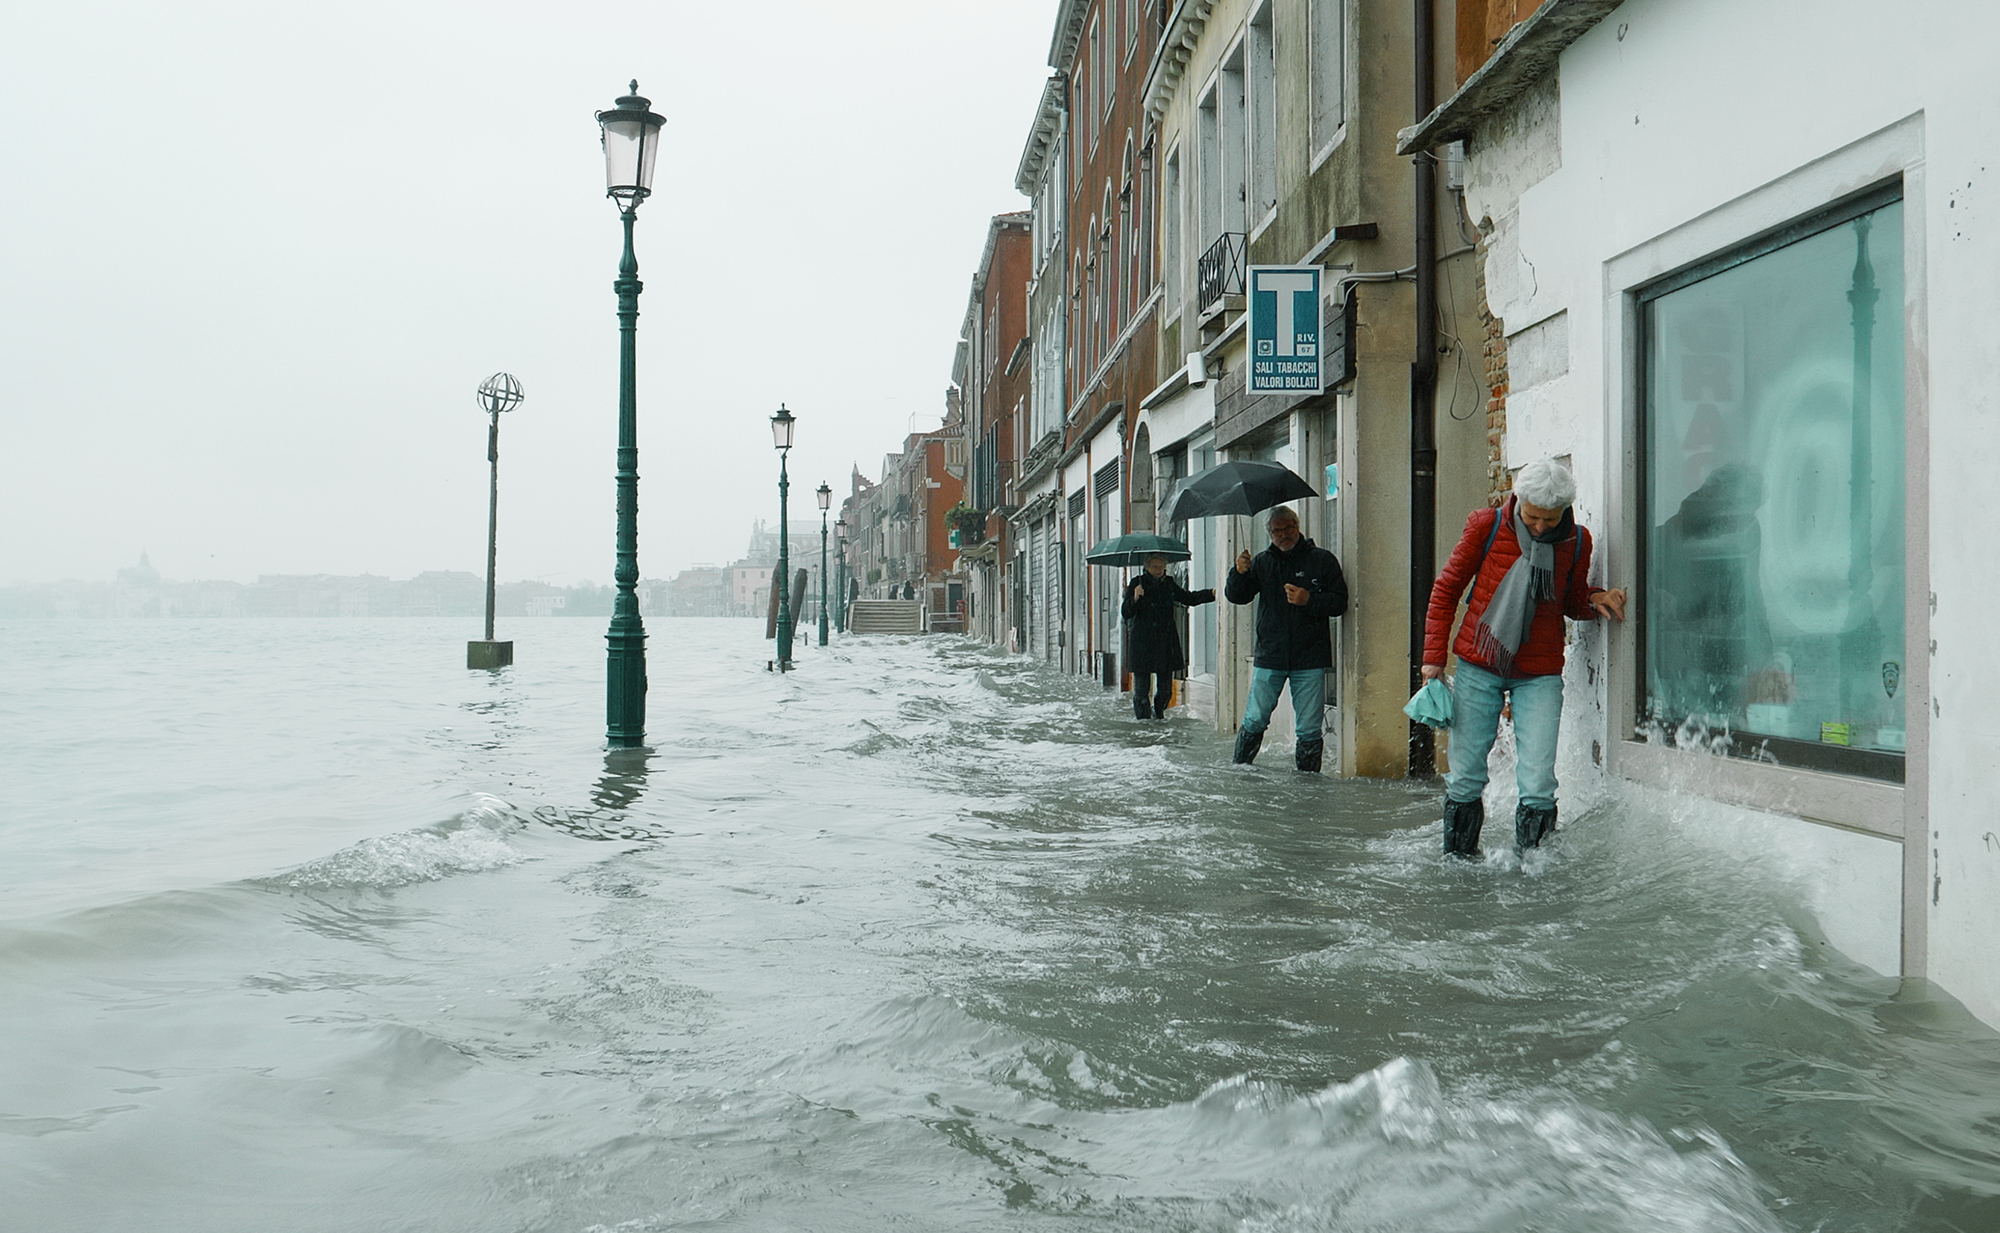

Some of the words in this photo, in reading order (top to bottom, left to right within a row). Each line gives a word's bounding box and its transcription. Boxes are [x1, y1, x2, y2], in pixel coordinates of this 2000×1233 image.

[1257, 273, 1313, 356] T
[1297, 333, 1315, 342] RIV.
[1255, 362, 1273, 373] SALI
[1277, 362, 1316, 373] TABACCHI
[1255, 376, 1283, 388] VALORI
[1285, 376, 1317, 388] BOLLATI
